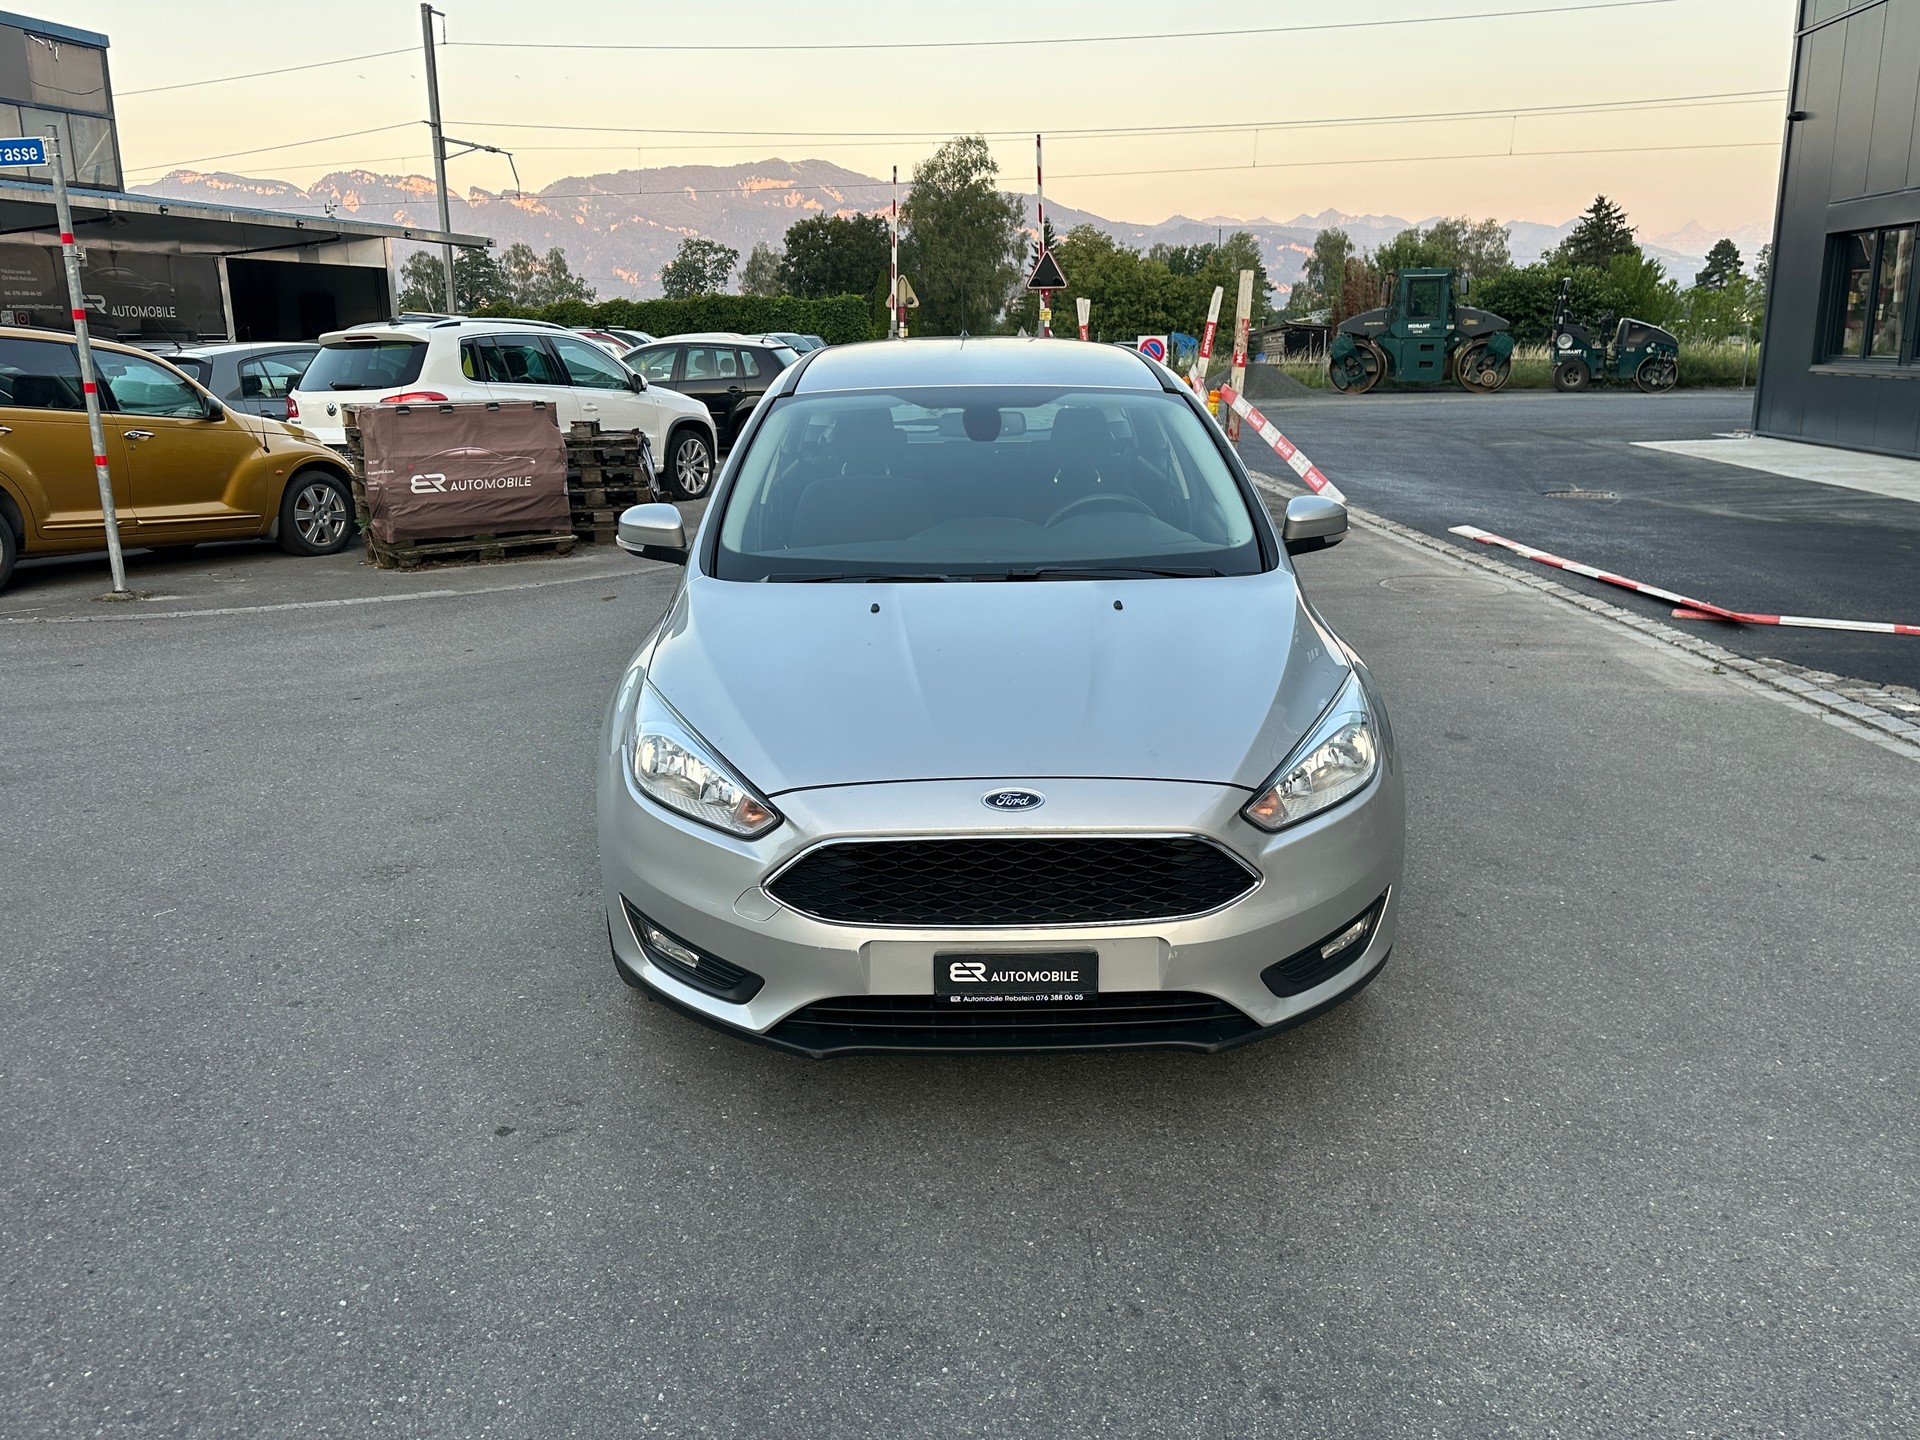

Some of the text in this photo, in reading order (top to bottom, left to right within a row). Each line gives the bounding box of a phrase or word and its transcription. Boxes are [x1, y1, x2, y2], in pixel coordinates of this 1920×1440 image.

[112, 305, 176, 318] AUTOMOBILE
[450, 476, 532, 491] AUTOMOBILE
[996, 793, 1030, 806] Ford
[991, 971, 1079, 982] AUTOMOBILE
[1004, 994, 1034, 1002] Rebstein
